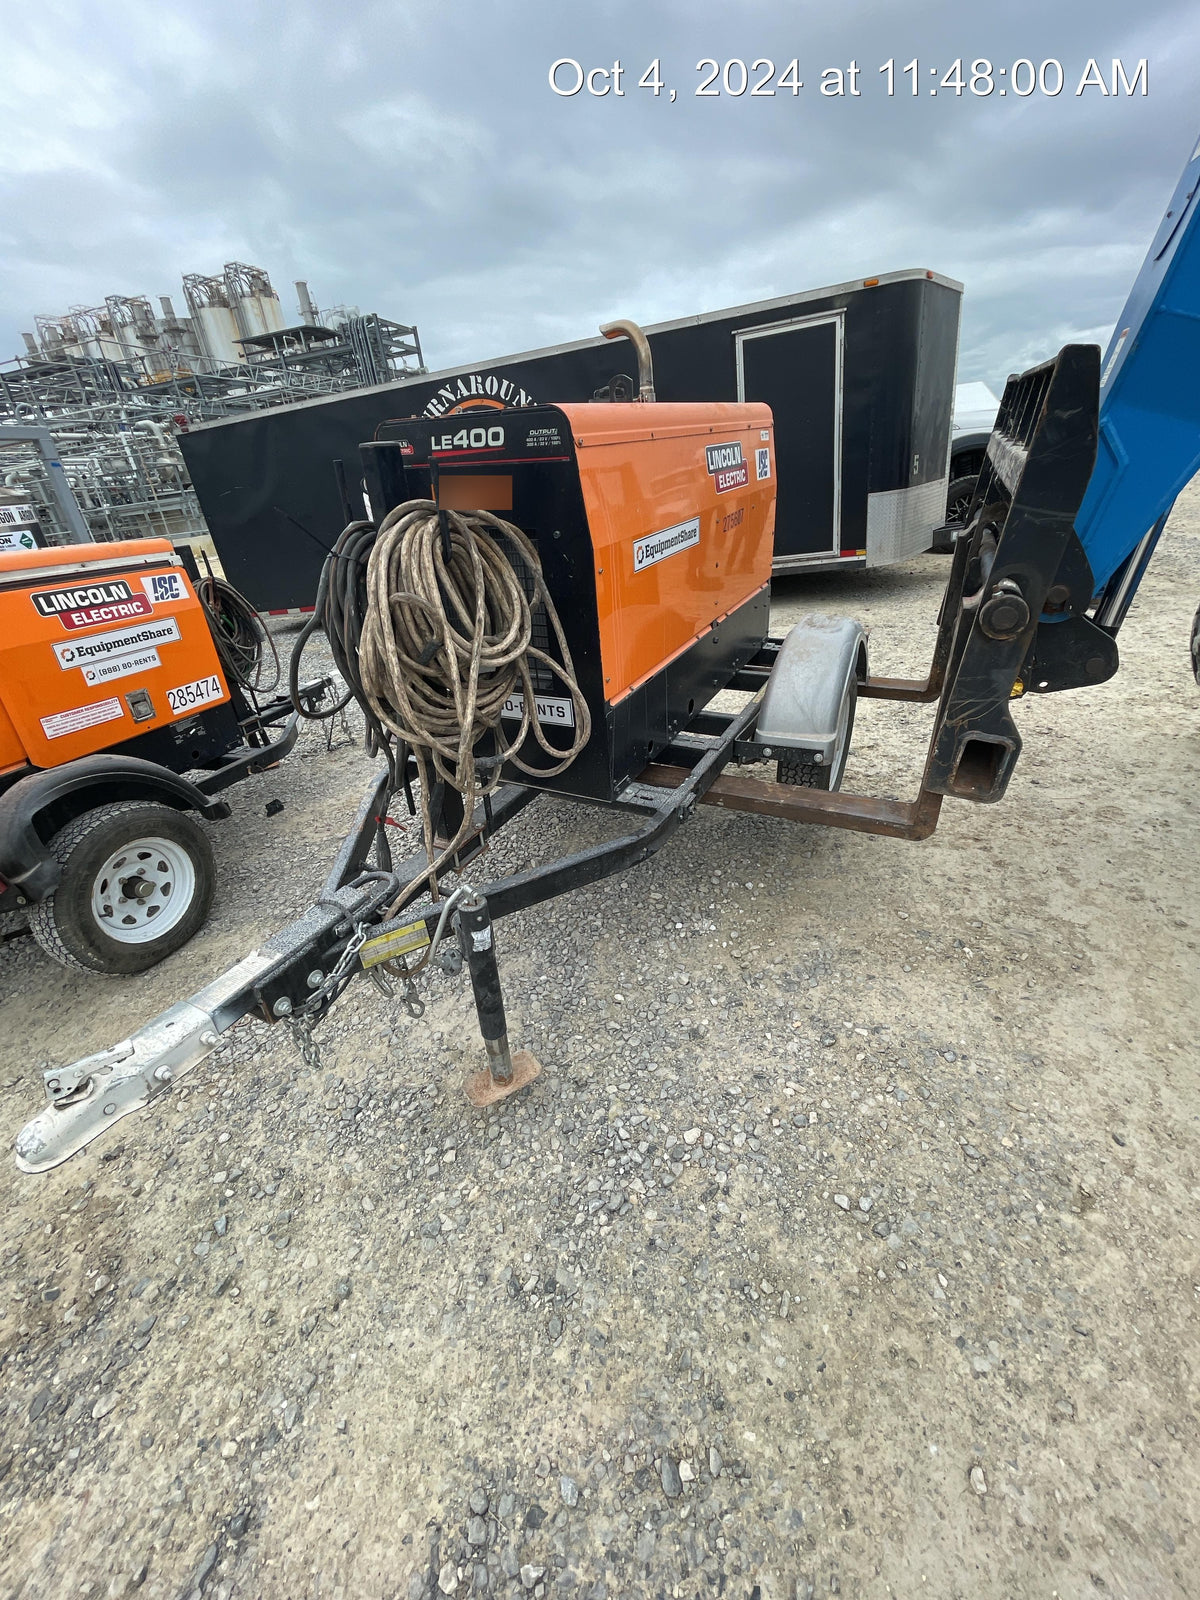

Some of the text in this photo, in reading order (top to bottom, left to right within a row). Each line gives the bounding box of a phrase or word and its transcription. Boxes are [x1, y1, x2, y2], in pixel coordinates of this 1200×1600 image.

[421, 375, 539, 417] RNAROUN
[431, 426, 505, 450] LE400
[708, 446, 741, 471] LINCOLN
[913, 454, 920, 475] 5
[719, 468, 746, 489] ELECTRIC
[645, 527, 698, 558] EquipmentShare
[38, 584, 129, 613] LINCOLN
[151, 575, 180, 601] ISC
[71, 601, 144, 625] ELECTRIC
[76, 626, 174, 658] EquipmentShare
[98, 654, 157, 677] (888) 80-RENTS
[167, 677, 221, 710] 285474
